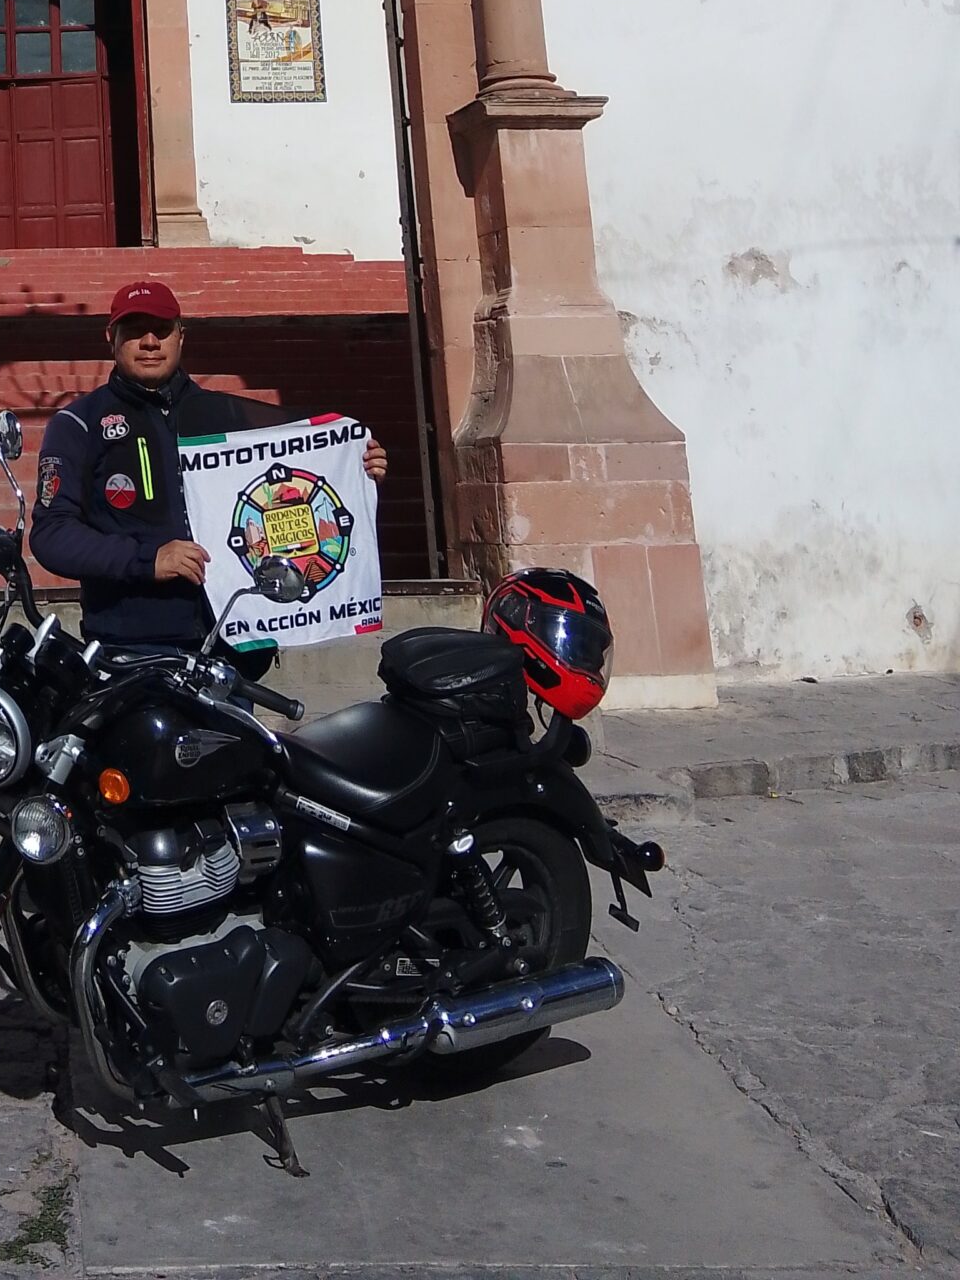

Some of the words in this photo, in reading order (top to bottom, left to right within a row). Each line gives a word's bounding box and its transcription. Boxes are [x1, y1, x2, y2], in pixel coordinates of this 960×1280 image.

[106, 423, 126, 438] 66
[180, 422, 367, 471] MOTOTURISMO
[272, 467, 286, 480] N
[338, 515, 351, 527] E
[230, 535, 243, 548] O
[225, 619, 250, 638] EN
[256, 607, 322, 633] ACCIÓN
[329, 597, 382, 621] MÉXIC
